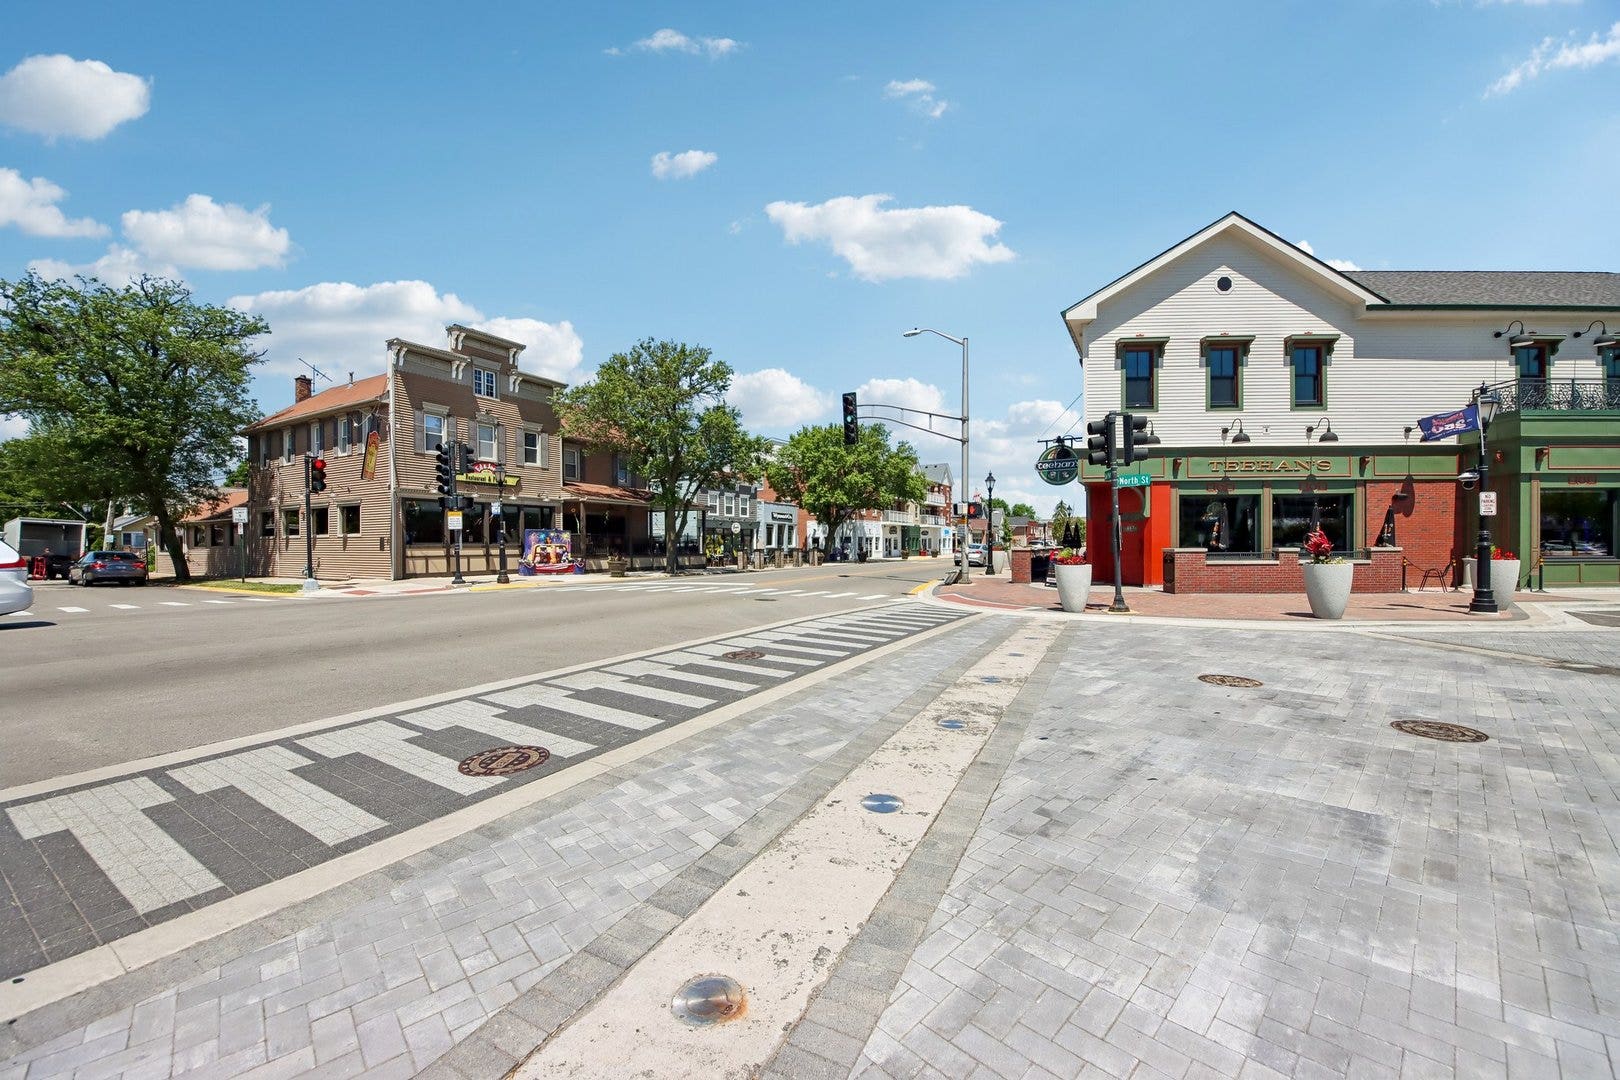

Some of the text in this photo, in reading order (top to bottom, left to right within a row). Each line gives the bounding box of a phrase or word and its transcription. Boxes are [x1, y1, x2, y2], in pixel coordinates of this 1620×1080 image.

[1208, 459, 1332, 473] TEEHAN'S
[1119, 475, 1149, 485] North St
